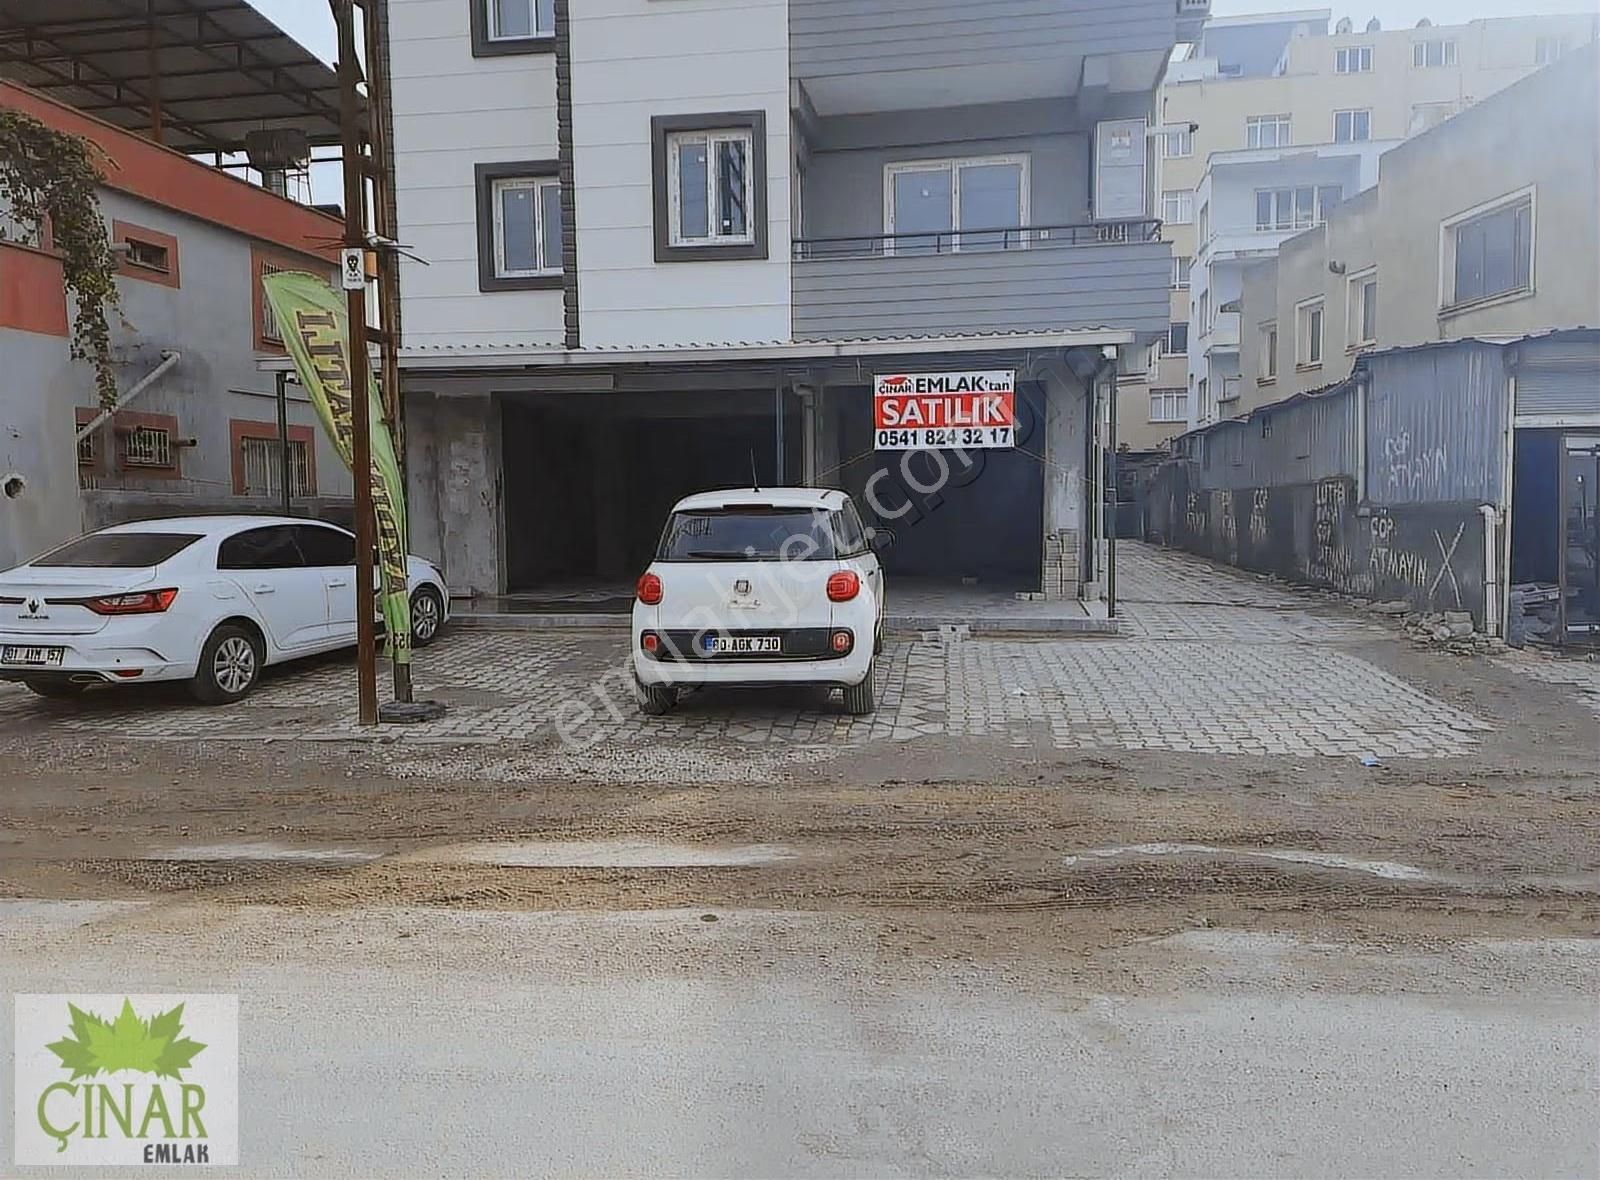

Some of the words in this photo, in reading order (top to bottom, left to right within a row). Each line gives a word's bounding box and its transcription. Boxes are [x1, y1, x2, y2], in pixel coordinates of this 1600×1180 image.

[882, 396, 1004, 426] SATILIK
[878, 430, 918, 446] 0541
[925, 429, 957, 445] 824
[963, 429, 983, 444] 32
[990, 427, 1009, 443] 17
[757, 638, 779, 650] 730
